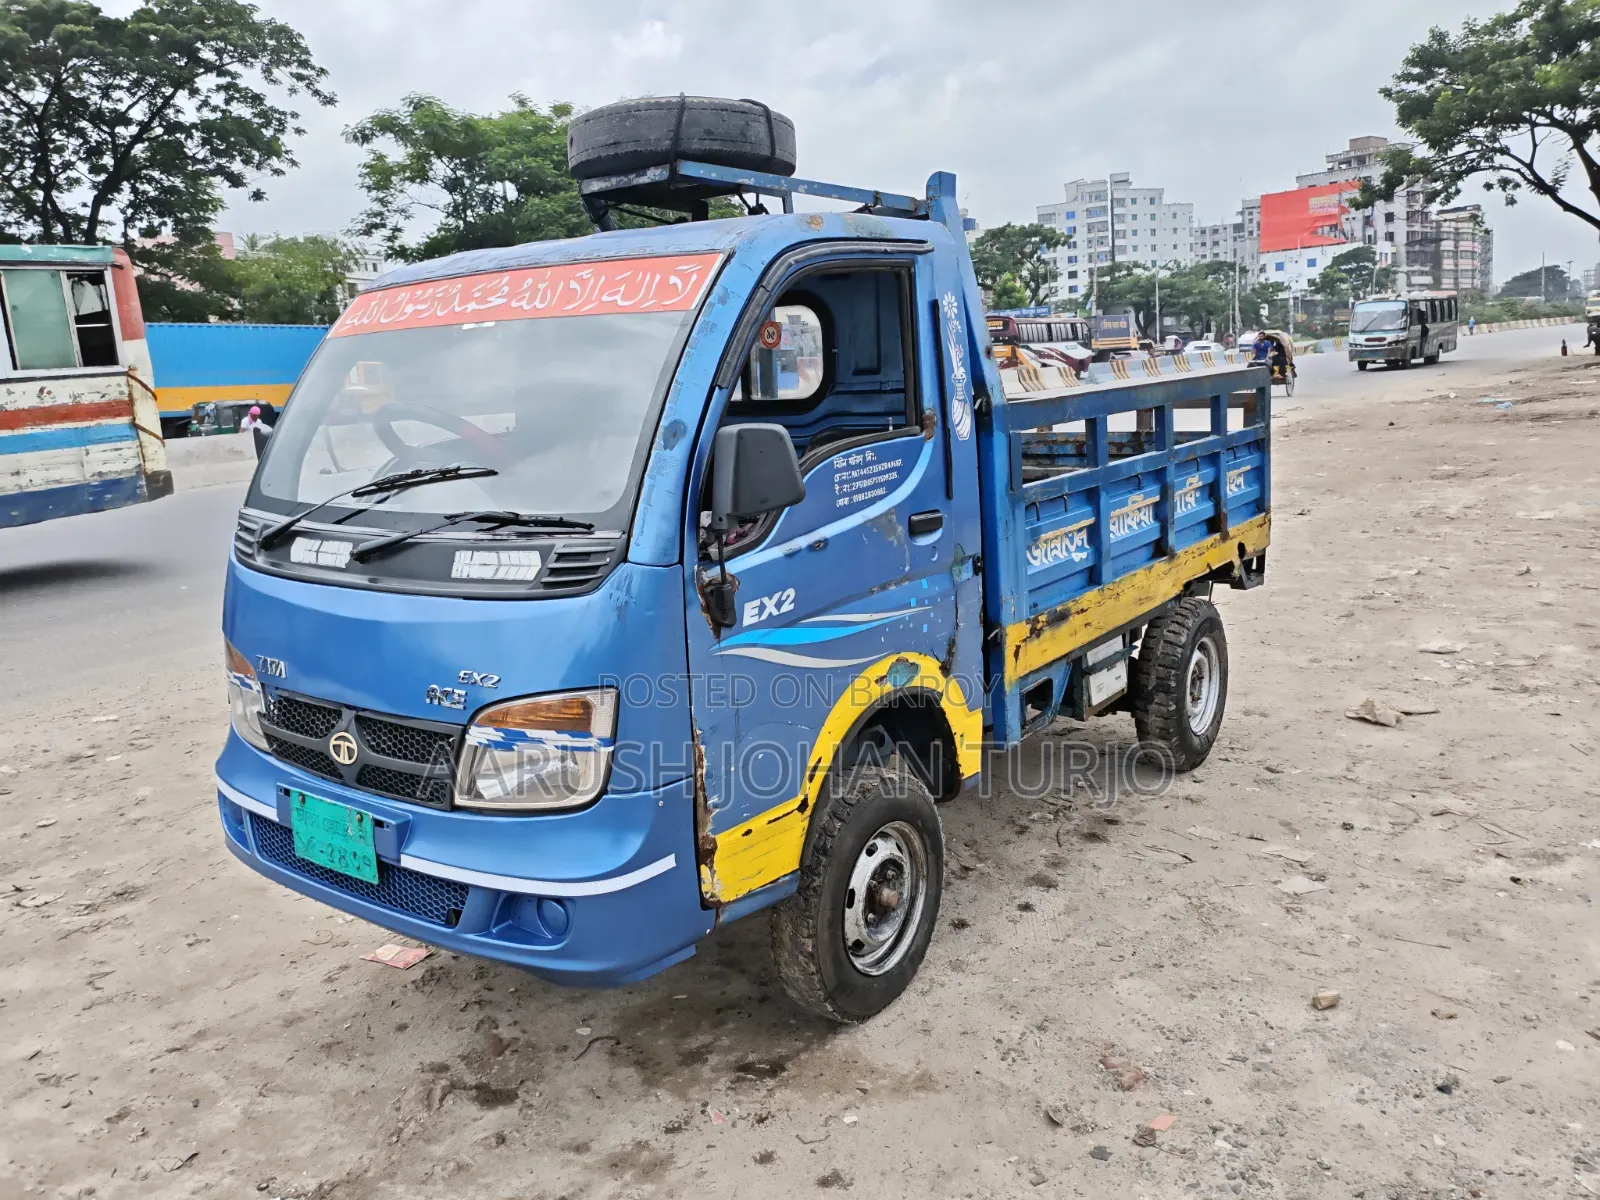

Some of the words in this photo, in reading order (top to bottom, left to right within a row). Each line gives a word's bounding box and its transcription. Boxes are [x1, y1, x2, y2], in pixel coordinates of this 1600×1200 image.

[742, 588, 796, 627] EX2
[458, 670, 501, 689] EX2
[426, 684, 468, 711] ACE
